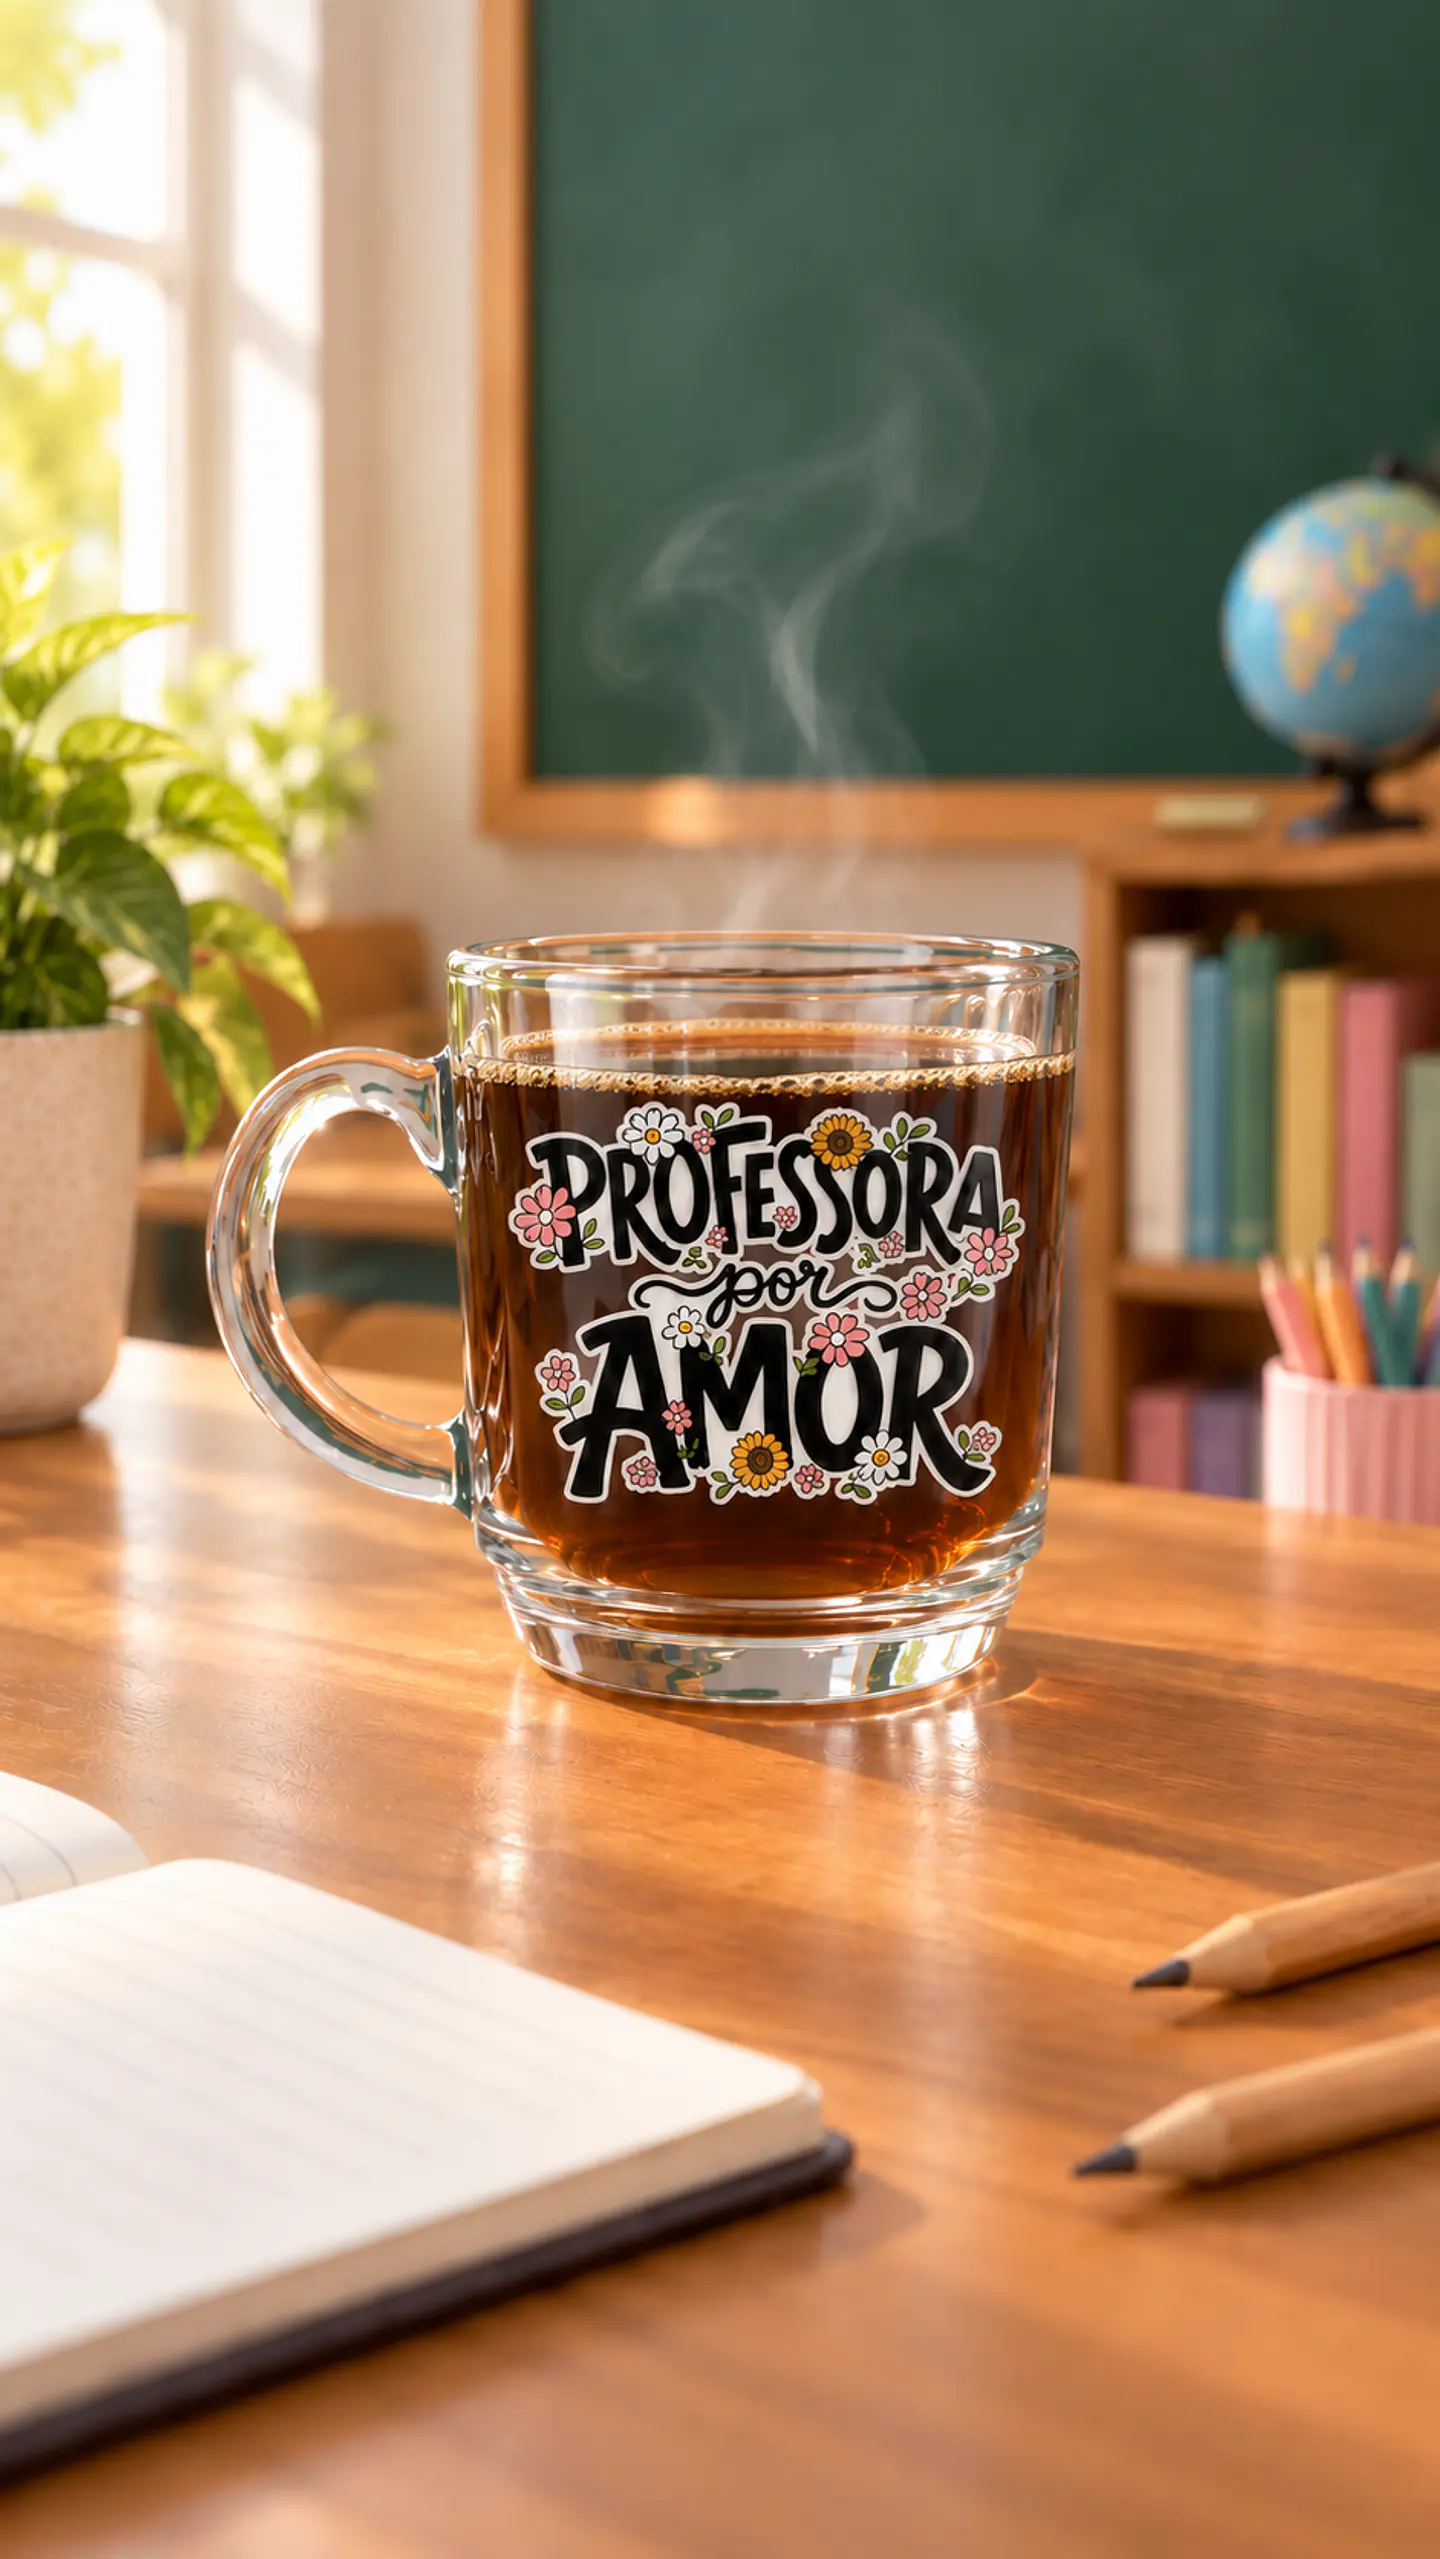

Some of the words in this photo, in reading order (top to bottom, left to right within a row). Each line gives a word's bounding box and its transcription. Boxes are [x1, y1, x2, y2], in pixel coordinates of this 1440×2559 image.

[531, 1121, 1000, 1267] PROFESSORA
[634, 1259, 897, 1327] por
[558, 1315, 996, 1496] AMOR
